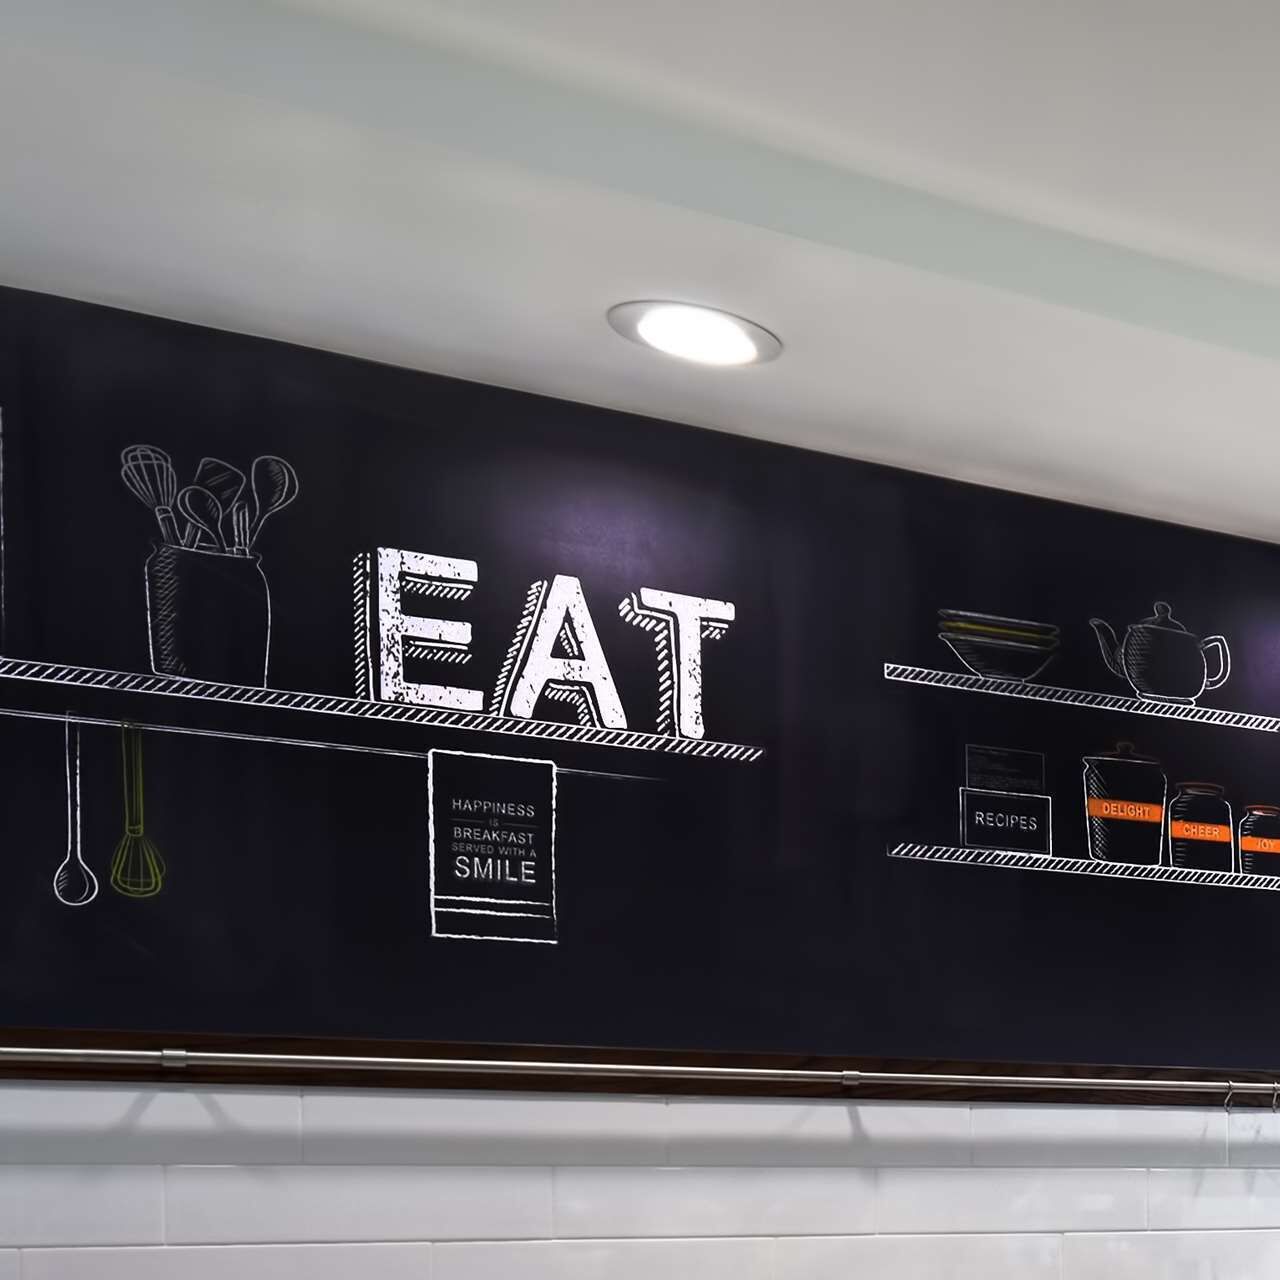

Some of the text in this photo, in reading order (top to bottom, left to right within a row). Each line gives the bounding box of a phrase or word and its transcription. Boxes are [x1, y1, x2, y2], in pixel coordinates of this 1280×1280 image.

[353, 546, 736, 739] EAT
[452, 799, 535, 817] HAPPINESS
[1102, 803, 1150, 819] DELIGHT
[975, 811, 1038, 831] RECIPES
[453, 826, 535, 845] BREAKFAST
[1182, 823, 1220, 838] CHEER
[451, 842, 537, 858] SERVED WITH A
[1256, 838, 1275, 849] JOY
[455, 856, 536, 883] SMILE
